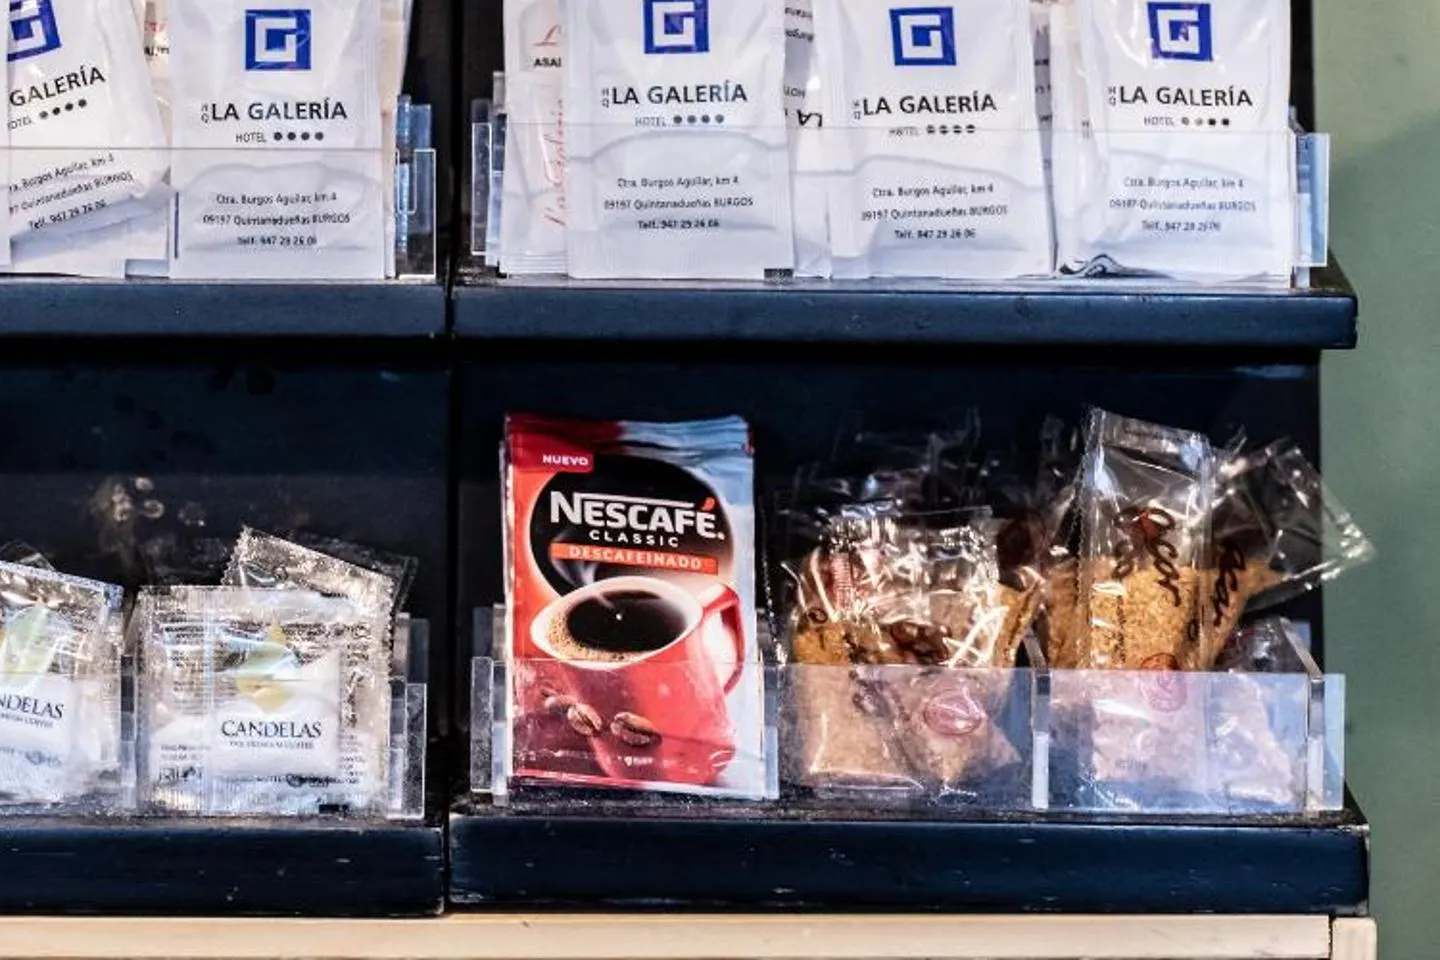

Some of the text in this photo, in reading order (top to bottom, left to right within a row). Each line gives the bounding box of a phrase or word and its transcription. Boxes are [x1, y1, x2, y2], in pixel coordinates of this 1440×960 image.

[10, 65, 106, 106] GALERÍA
[613, 79, 747, 104] LA GALERÍA
[1120, 86, 1147, 104] LA
[1156, 85, 1253, 106] GALERÍA
[212, 103, 240, 121] LA
[248, 98, 347, 120] GALERÍA
[863, 91, 997, 115] LA GALERÍA
[543, 454, 589, 465] NUEVO
[589, 530, 679, 547] CLASSIC
[570, 545, 702, 570] DESCAFEINADO
[221, 720, 322, 738] CANDELAS
